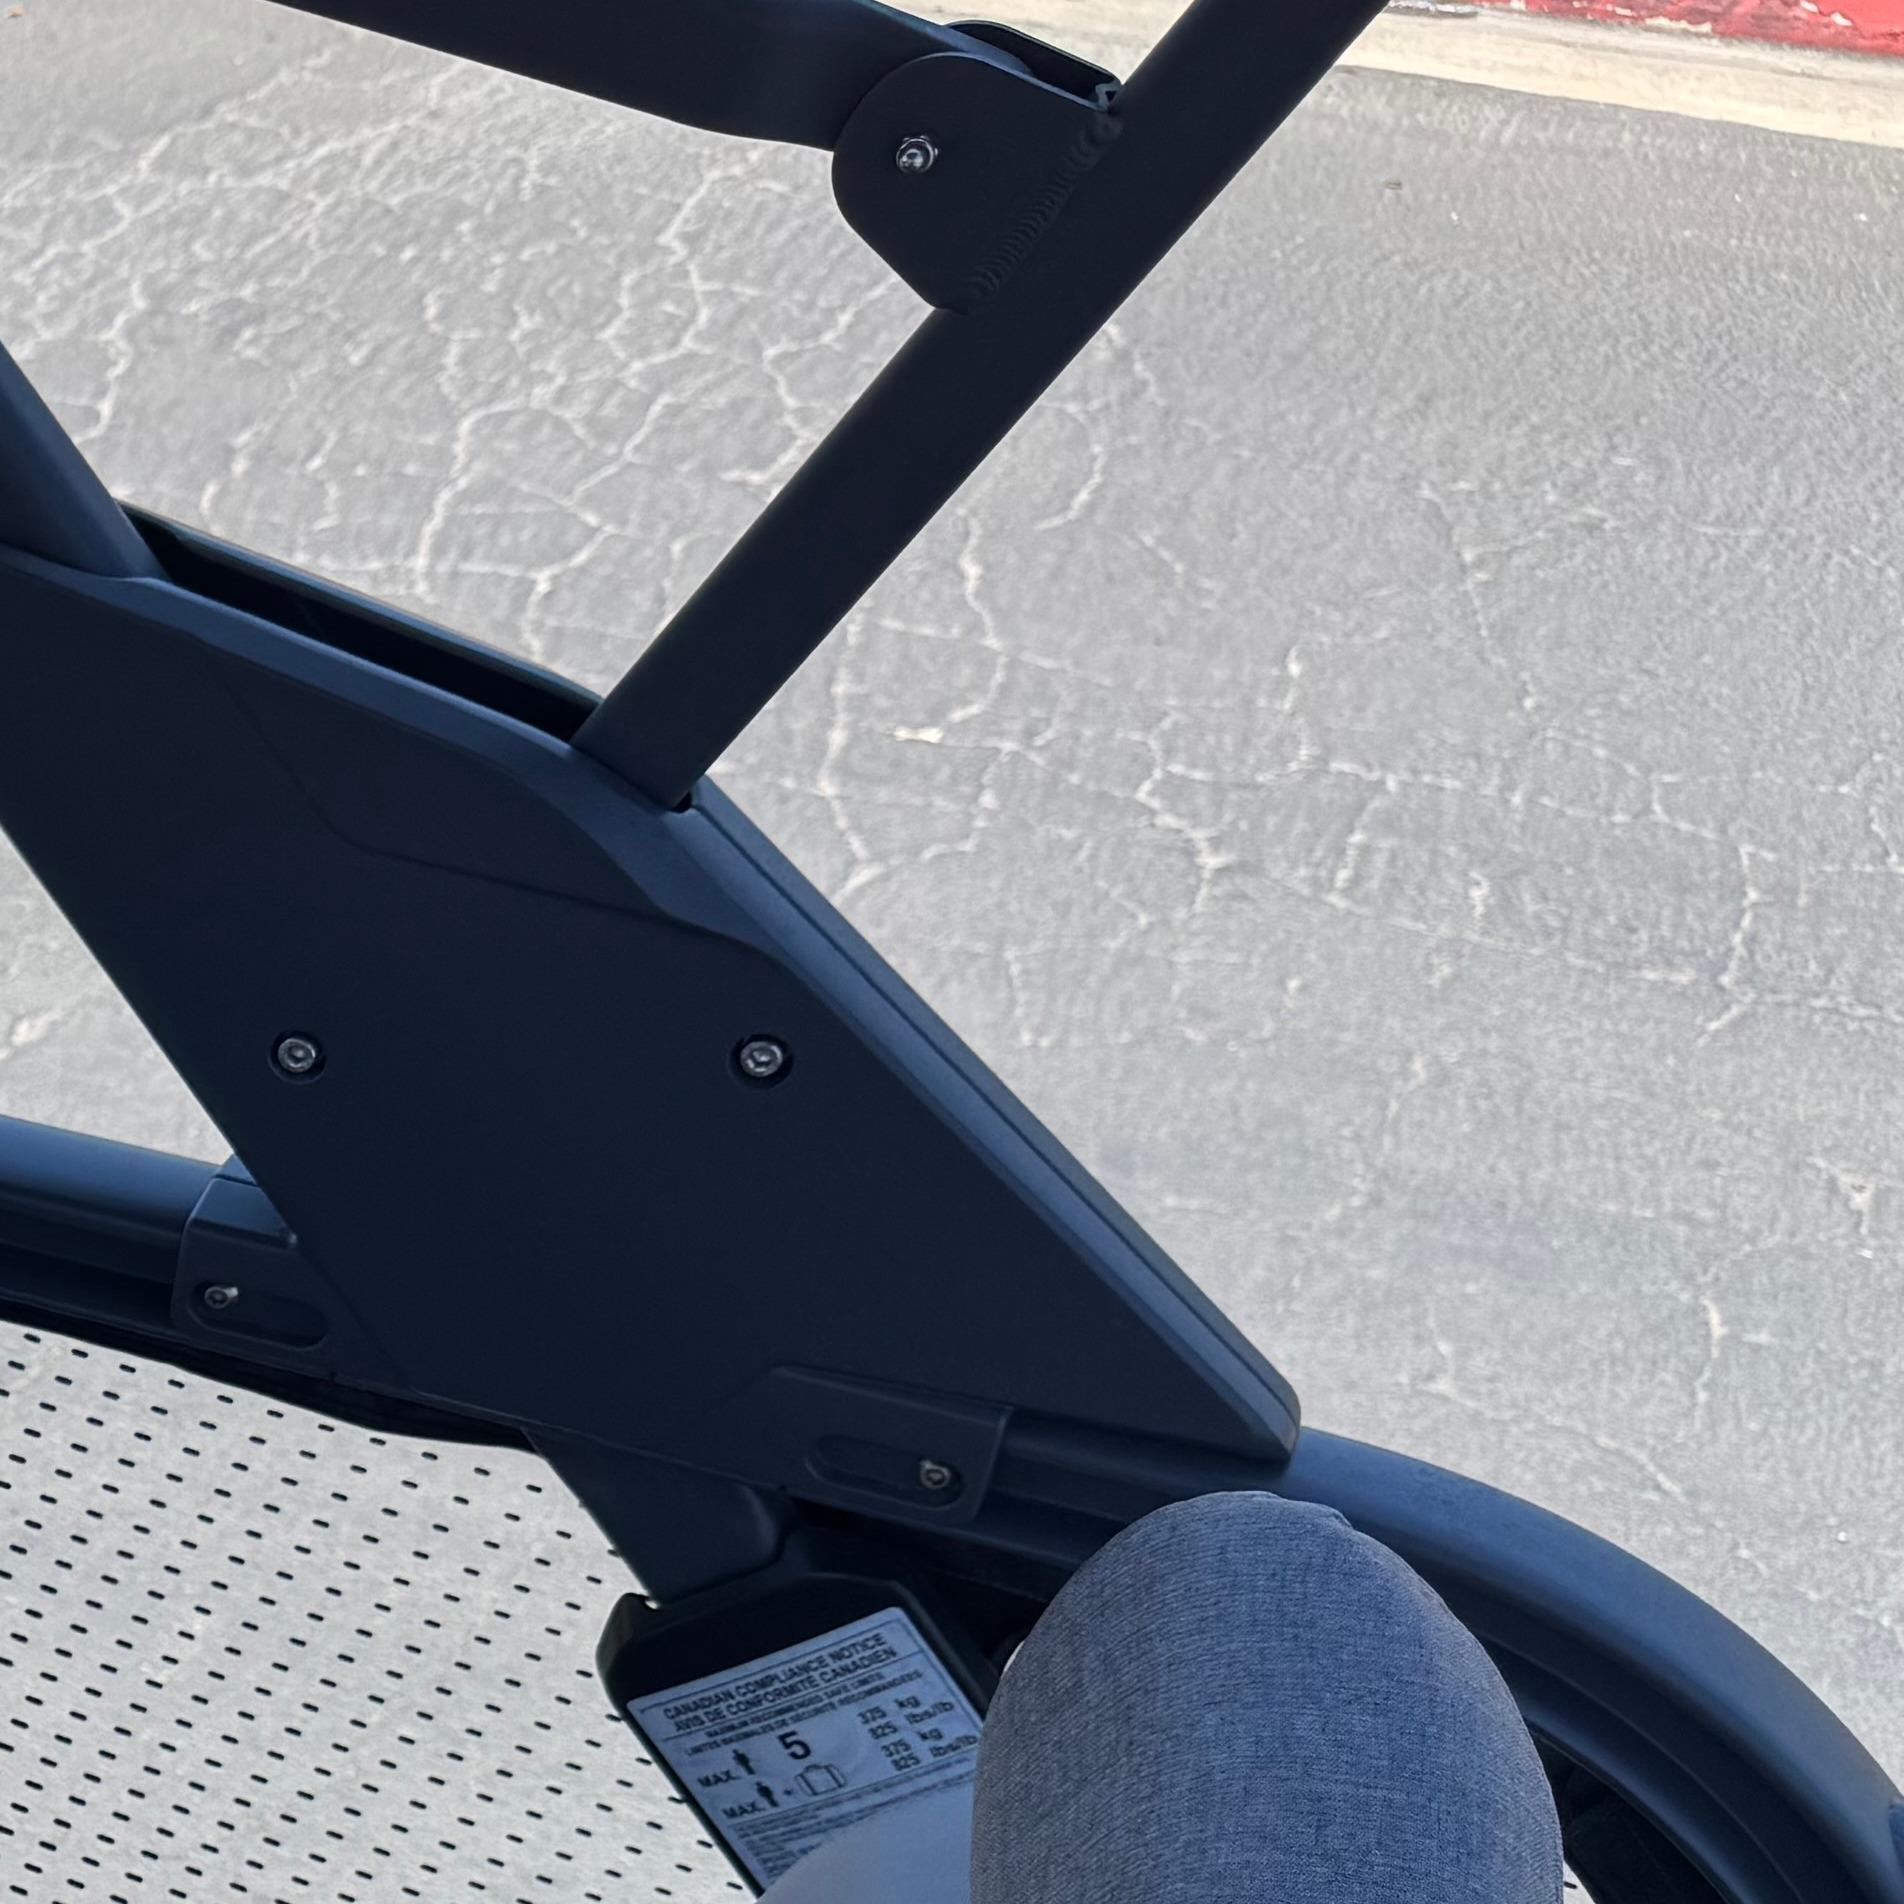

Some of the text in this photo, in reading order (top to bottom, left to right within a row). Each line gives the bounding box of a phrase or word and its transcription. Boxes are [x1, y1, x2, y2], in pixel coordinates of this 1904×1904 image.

[662, 1633, 887, 1722] CANADIAN COMPLIANCE NOTICE
[673, 1714, 706, 1734] AVIS
[705, 1707, 727, 1723] DE
[817, 1646, 898, 1683] CANADIEN
[857, 1694, 921, 1725] 375 kg
[778, 1731, 812, 1760] 5
[867, 1721, 898, 1740] 825
[880, 1727, 943, 1758] 375 kg
[697, 1769, 739, 1788] MAX.
[722, 1800, 765, 1819] MAX.
